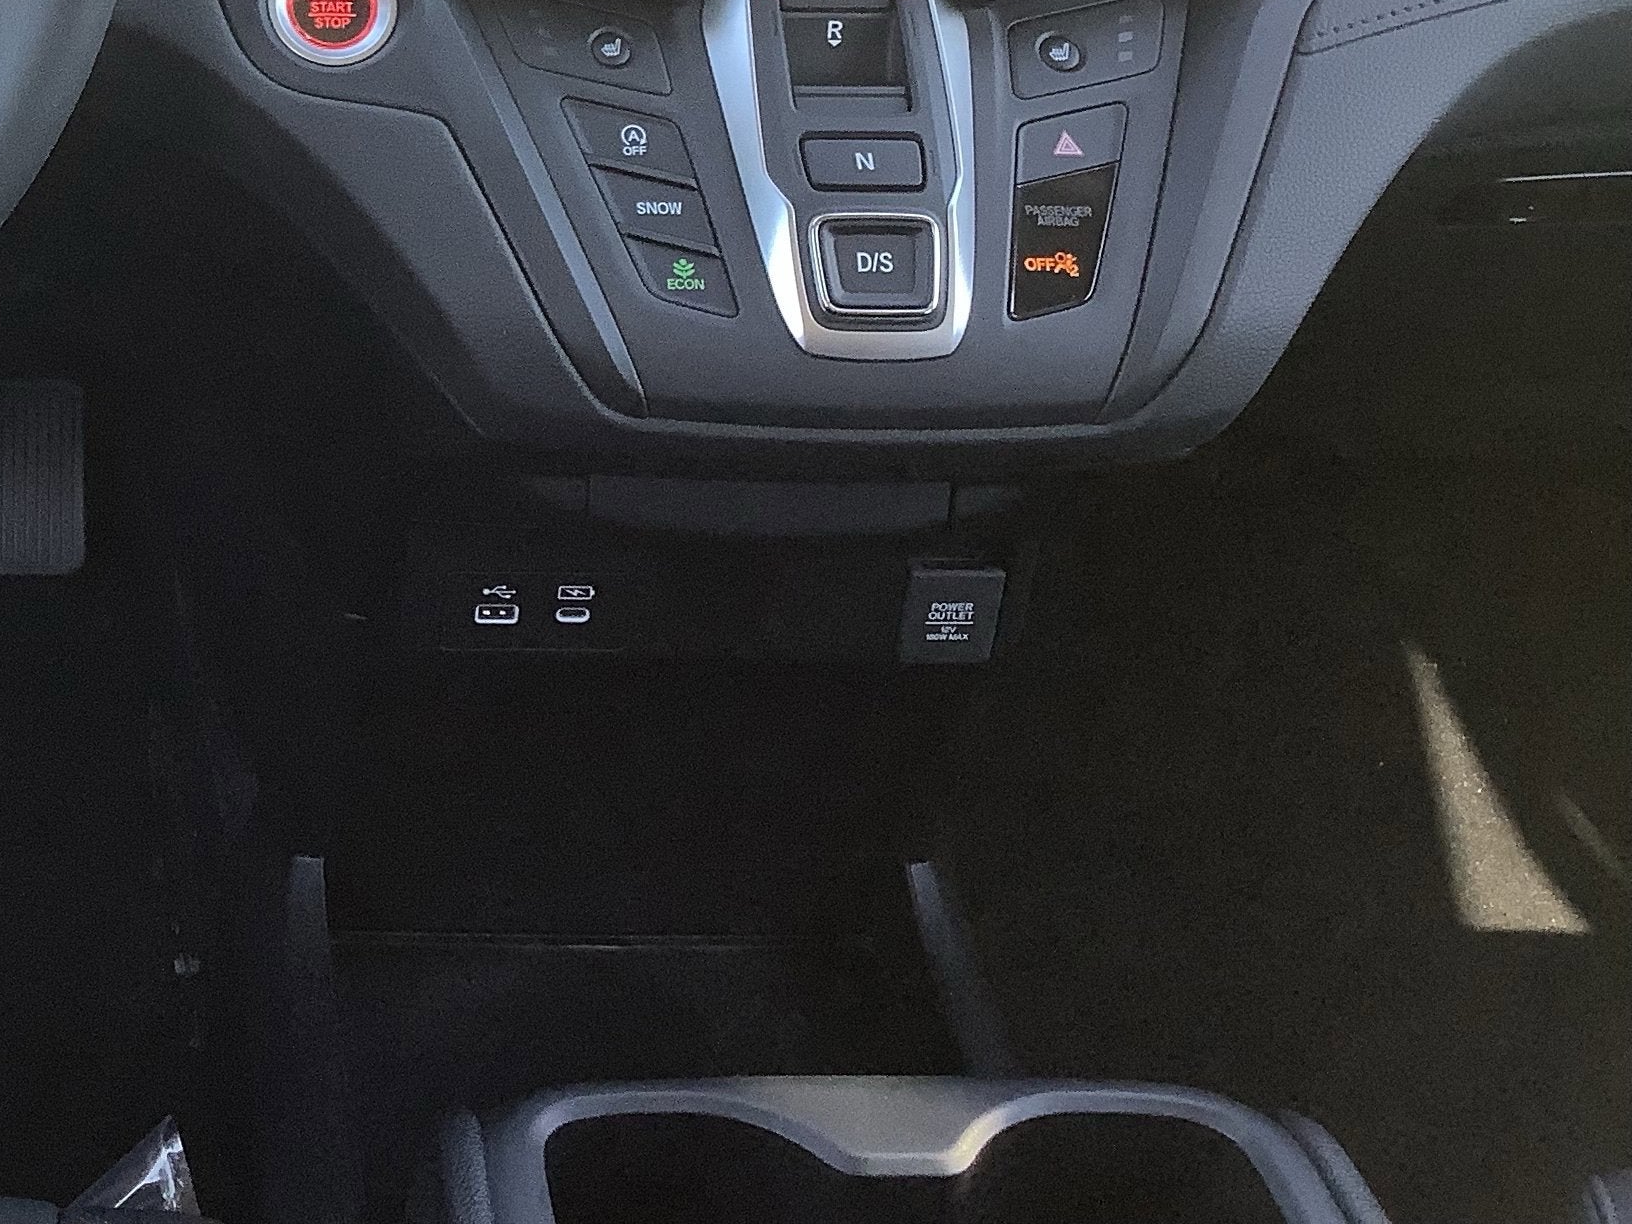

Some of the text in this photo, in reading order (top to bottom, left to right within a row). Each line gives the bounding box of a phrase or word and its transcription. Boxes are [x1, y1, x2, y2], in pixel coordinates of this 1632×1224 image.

[310, 1, 354, 13] START
[313, 17, 351, 29] STOP
[827, 20, 843, 40] R
[622, 145, 647, 157] OFF
[856, 151, 874, 170] N
[636, 202, 682, 216] SNOW
[1024, 205, 1092, 217] PASSENGER
[1037, 216, 1080, 227] AIRBAG
[856, 251, 894, 274] D/S
[1024, 257, 1055, 272] OFF
[667, 278, 705, 291] ECON
[930, 603, 974, 611] POWER
[928, 612, 974, 620] OUTLET
